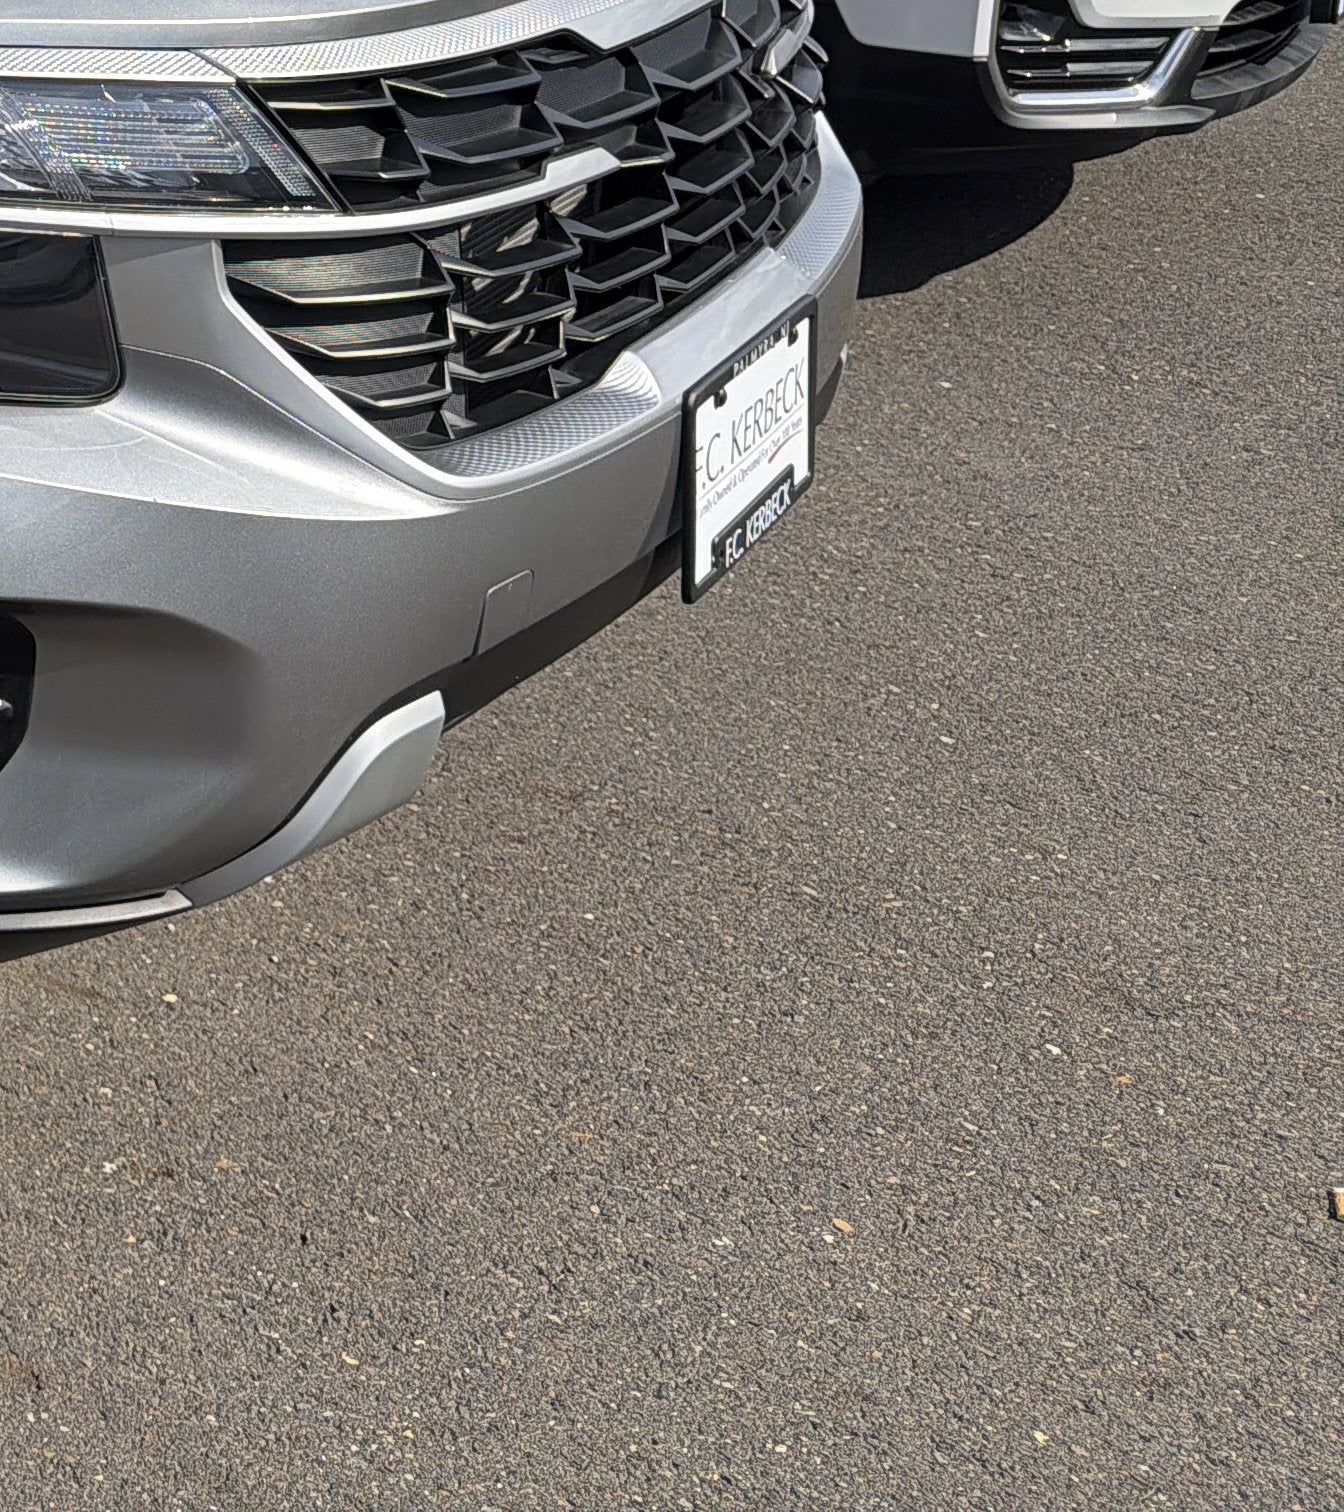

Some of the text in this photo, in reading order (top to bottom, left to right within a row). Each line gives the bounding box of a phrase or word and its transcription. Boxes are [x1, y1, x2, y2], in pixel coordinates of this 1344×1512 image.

[733, 334, 774, 378] PALMYRA
[730, 356, 806, 465] KERBECK
[745, 478, 792, 549] KERBECK
